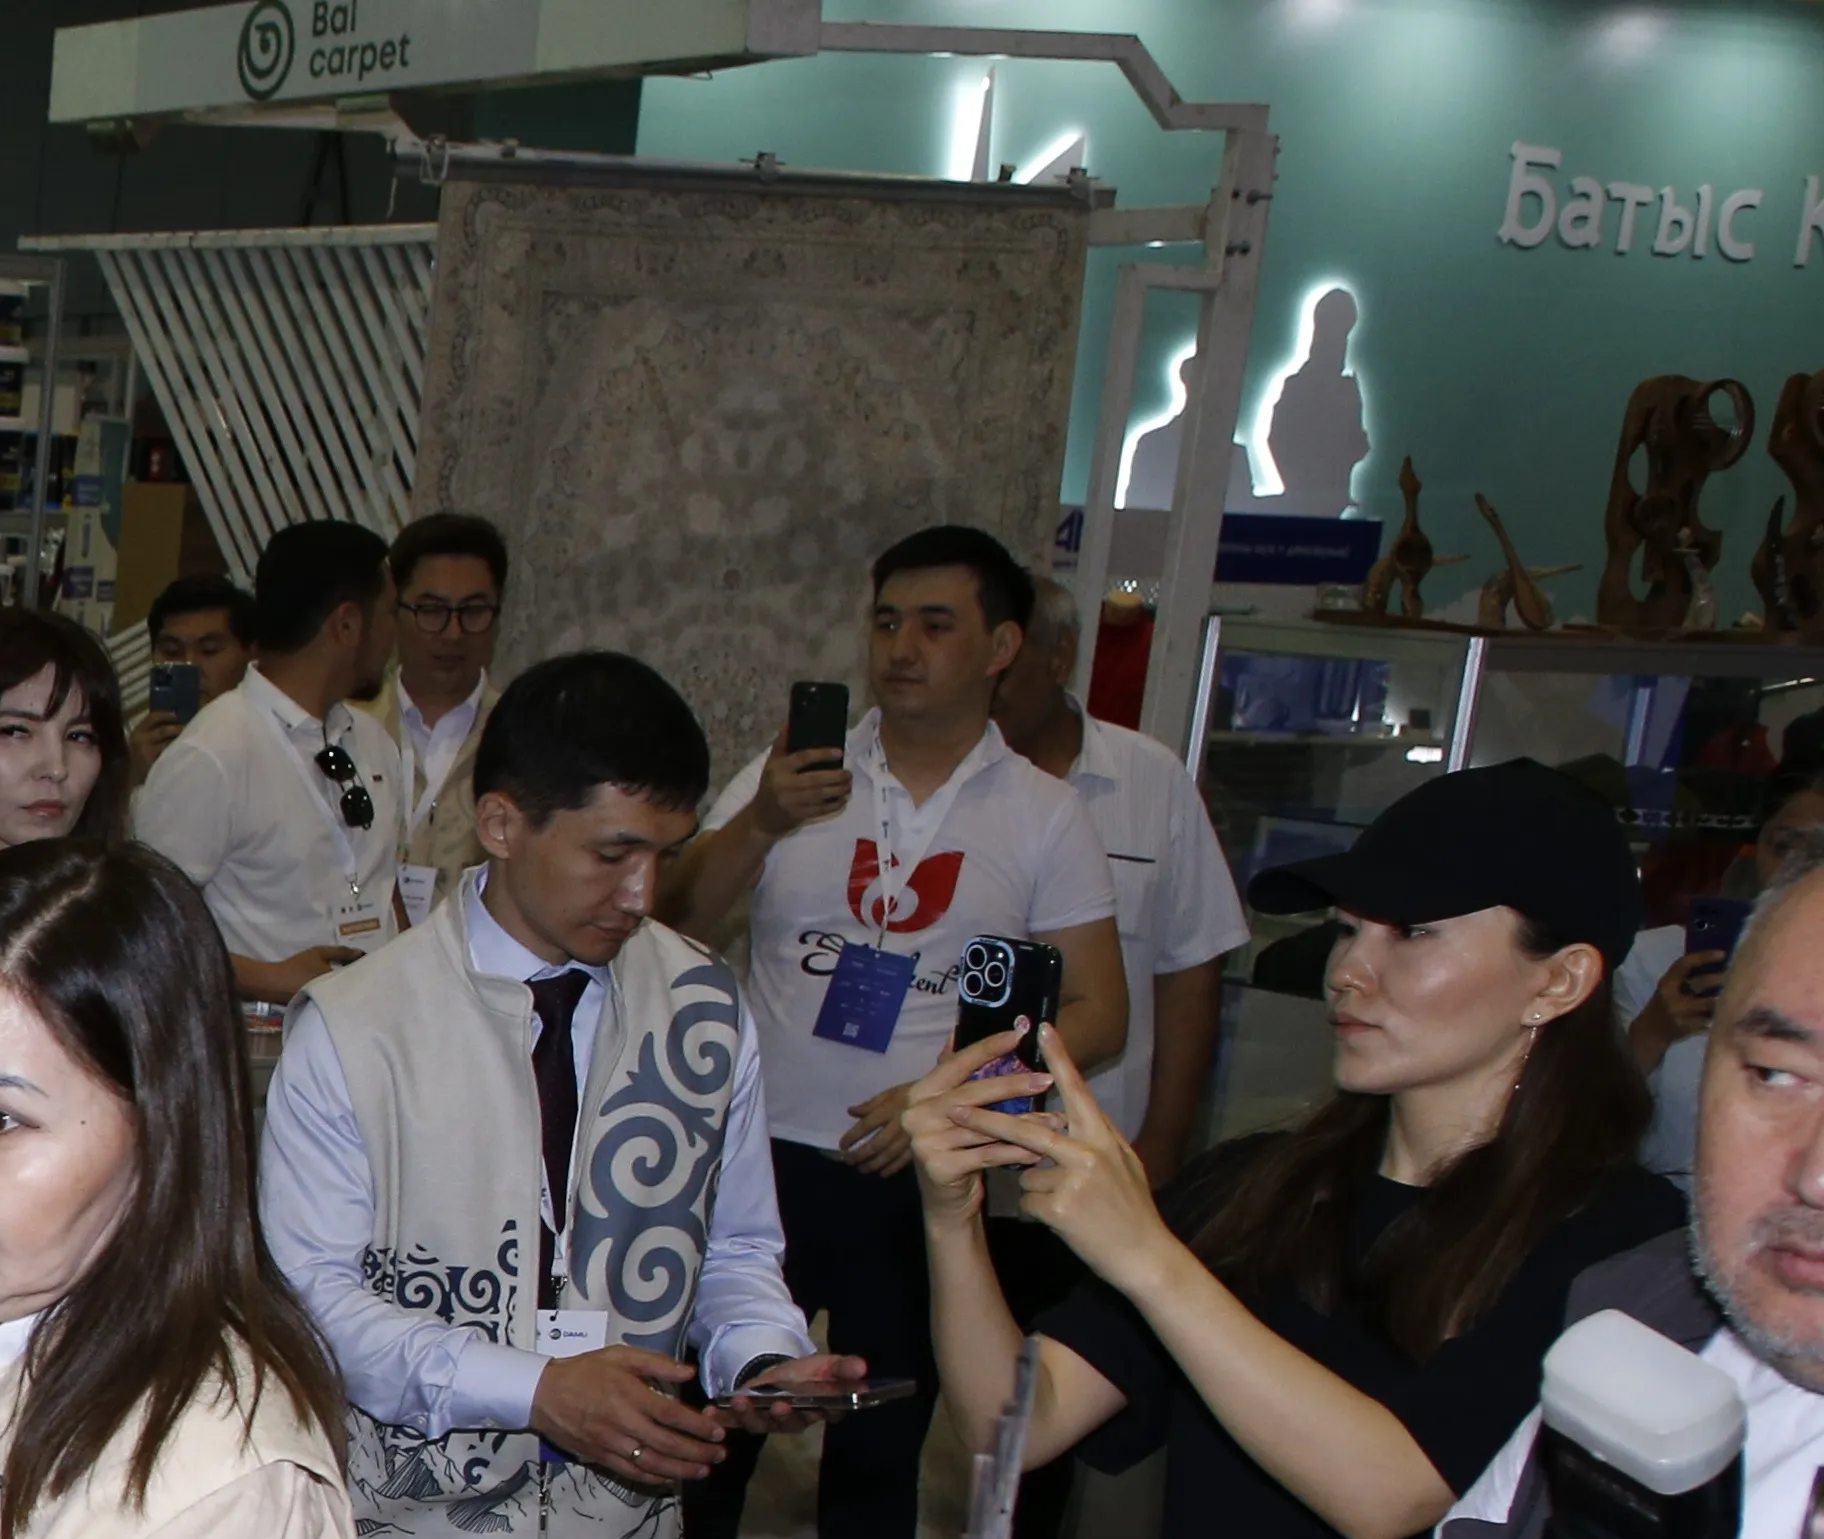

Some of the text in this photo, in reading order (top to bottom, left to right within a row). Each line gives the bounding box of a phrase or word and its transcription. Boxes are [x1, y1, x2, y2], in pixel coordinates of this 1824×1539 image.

[312, 0, 357, 37] Bal
[309, 33, 411, 81] carpet
[1497, 139, 1764, 263] Батыс
